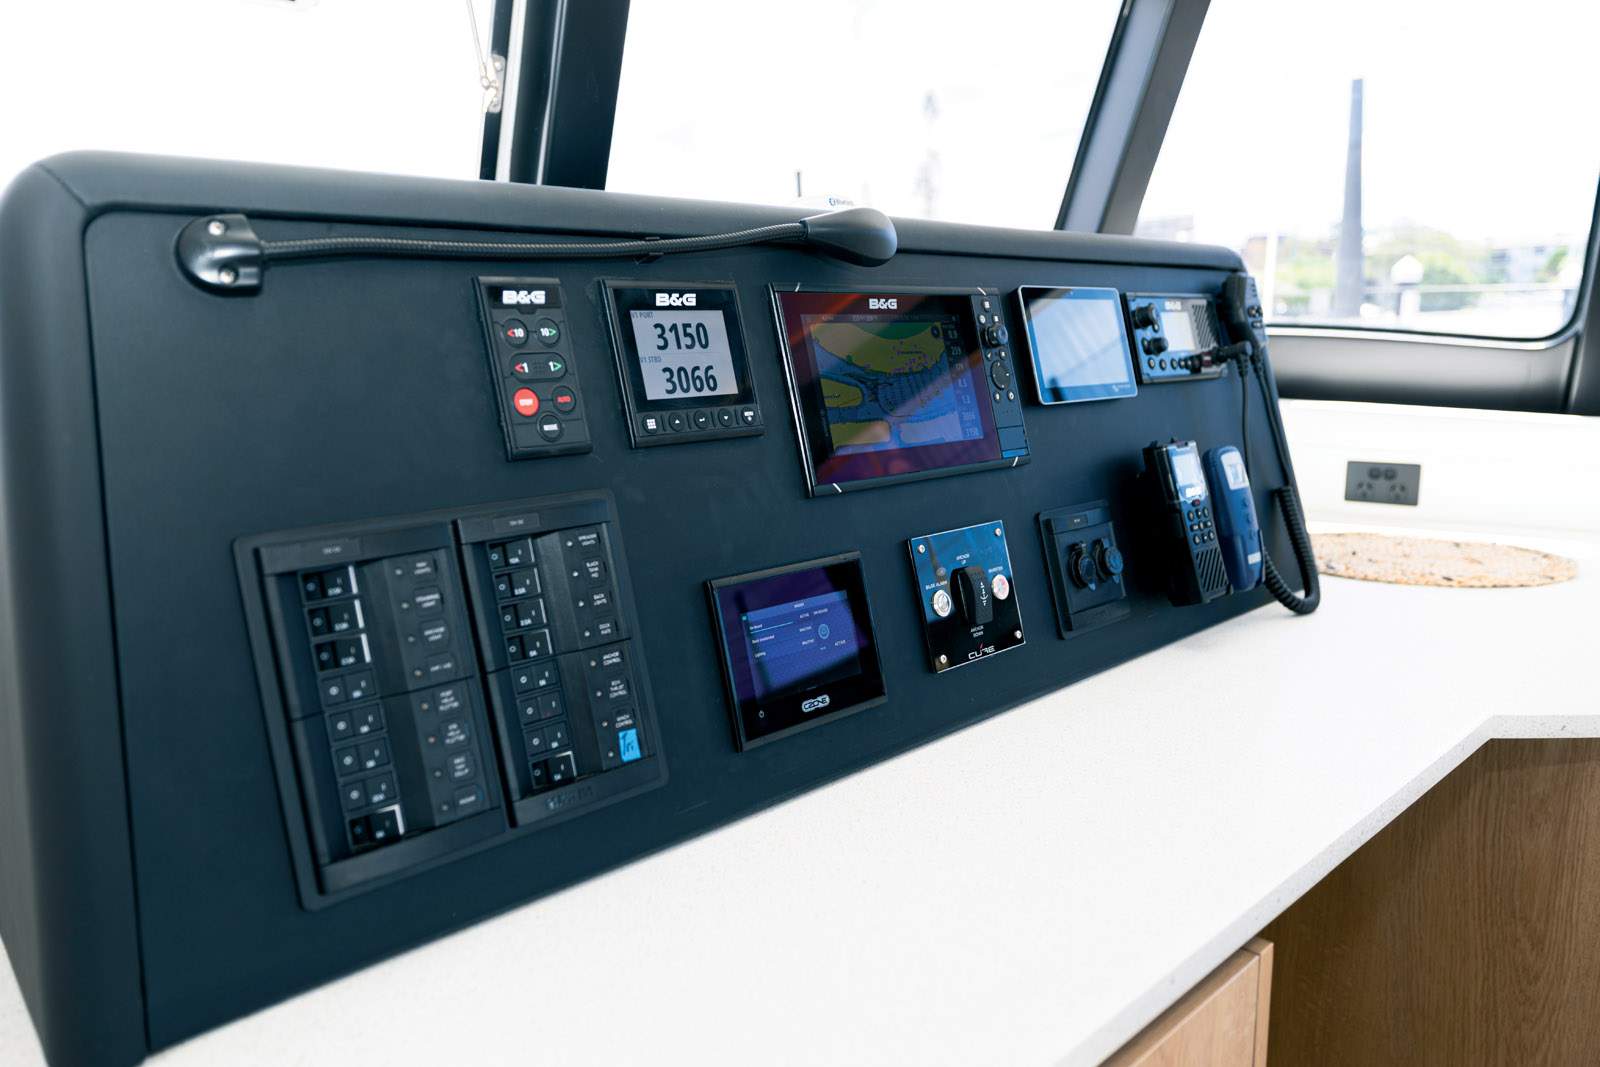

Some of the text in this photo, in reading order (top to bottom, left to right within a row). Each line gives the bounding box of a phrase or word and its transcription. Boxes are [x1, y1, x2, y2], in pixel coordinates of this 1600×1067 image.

[502, 290, 546, 304] B&G
[656, 293, 697, 306] B&G
[869, 299, 898, 310] B&G
[653, 322, 710, 350] 3150
[662, 365, 718, 394] 3066
[936, 580, 948, 588] ALARM
[970, 625, 984, 633] ANCHOR
